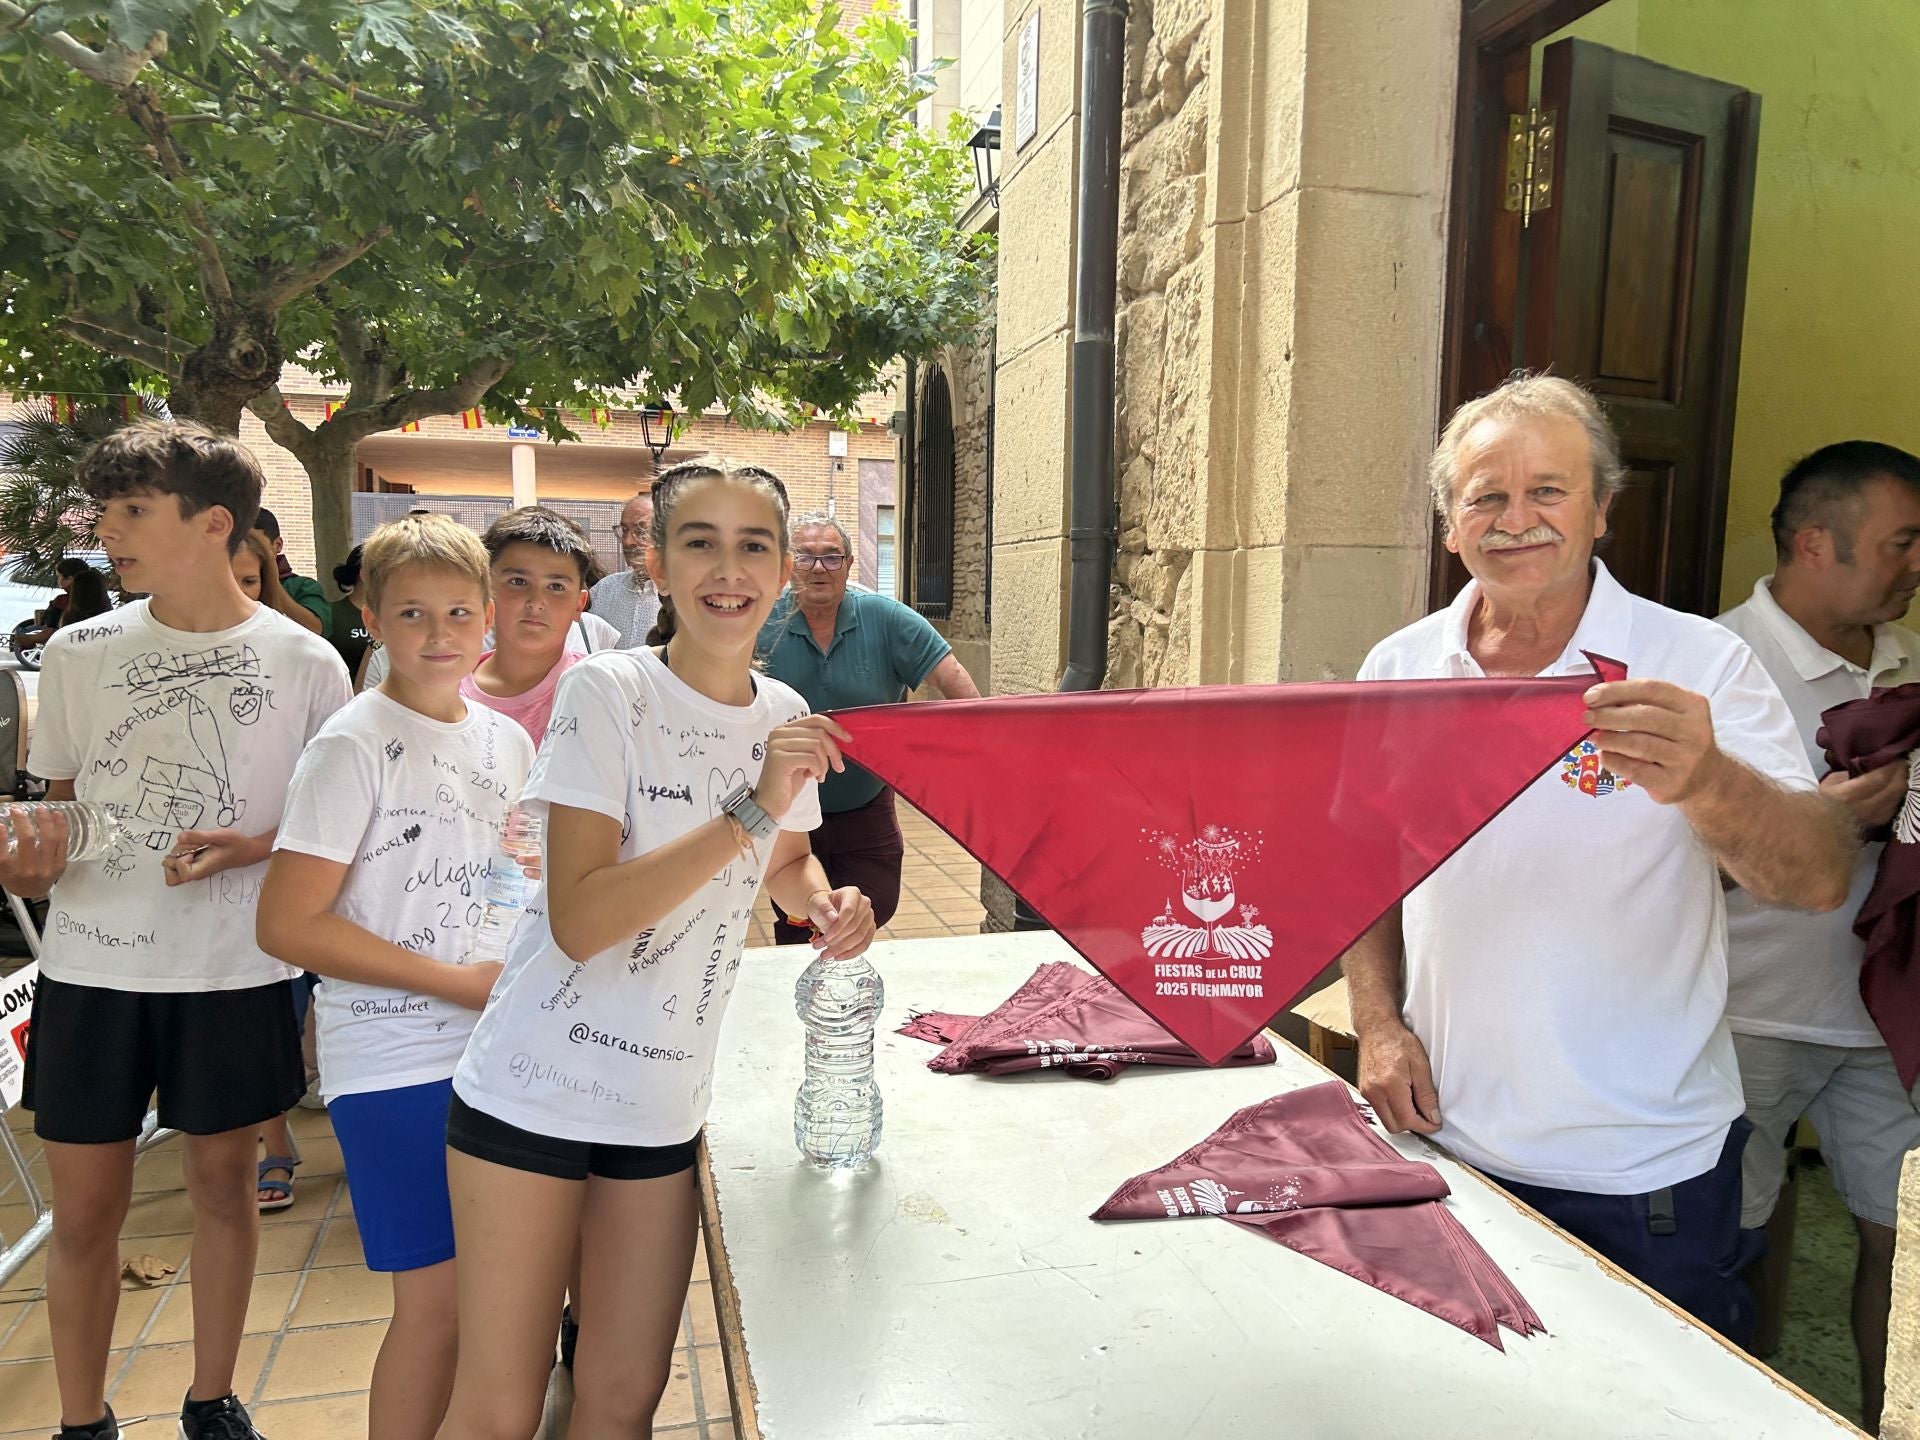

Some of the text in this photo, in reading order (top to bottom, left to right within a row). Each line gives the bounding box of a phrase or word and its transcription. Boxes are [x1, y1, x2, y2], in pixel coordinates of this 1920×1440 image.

[68, 624, 123, 643] TRIANA
[350, 628, 373, 639] SU
[471, 771, 507, 801] 2012
[1155, 964, 1263, 979] FIESTAS DE LA CRUZ
[1155, 982, 1264, 998] 2025 FUENMAYOR
[1172, 1186, 1196, 1214] FIESTAS
